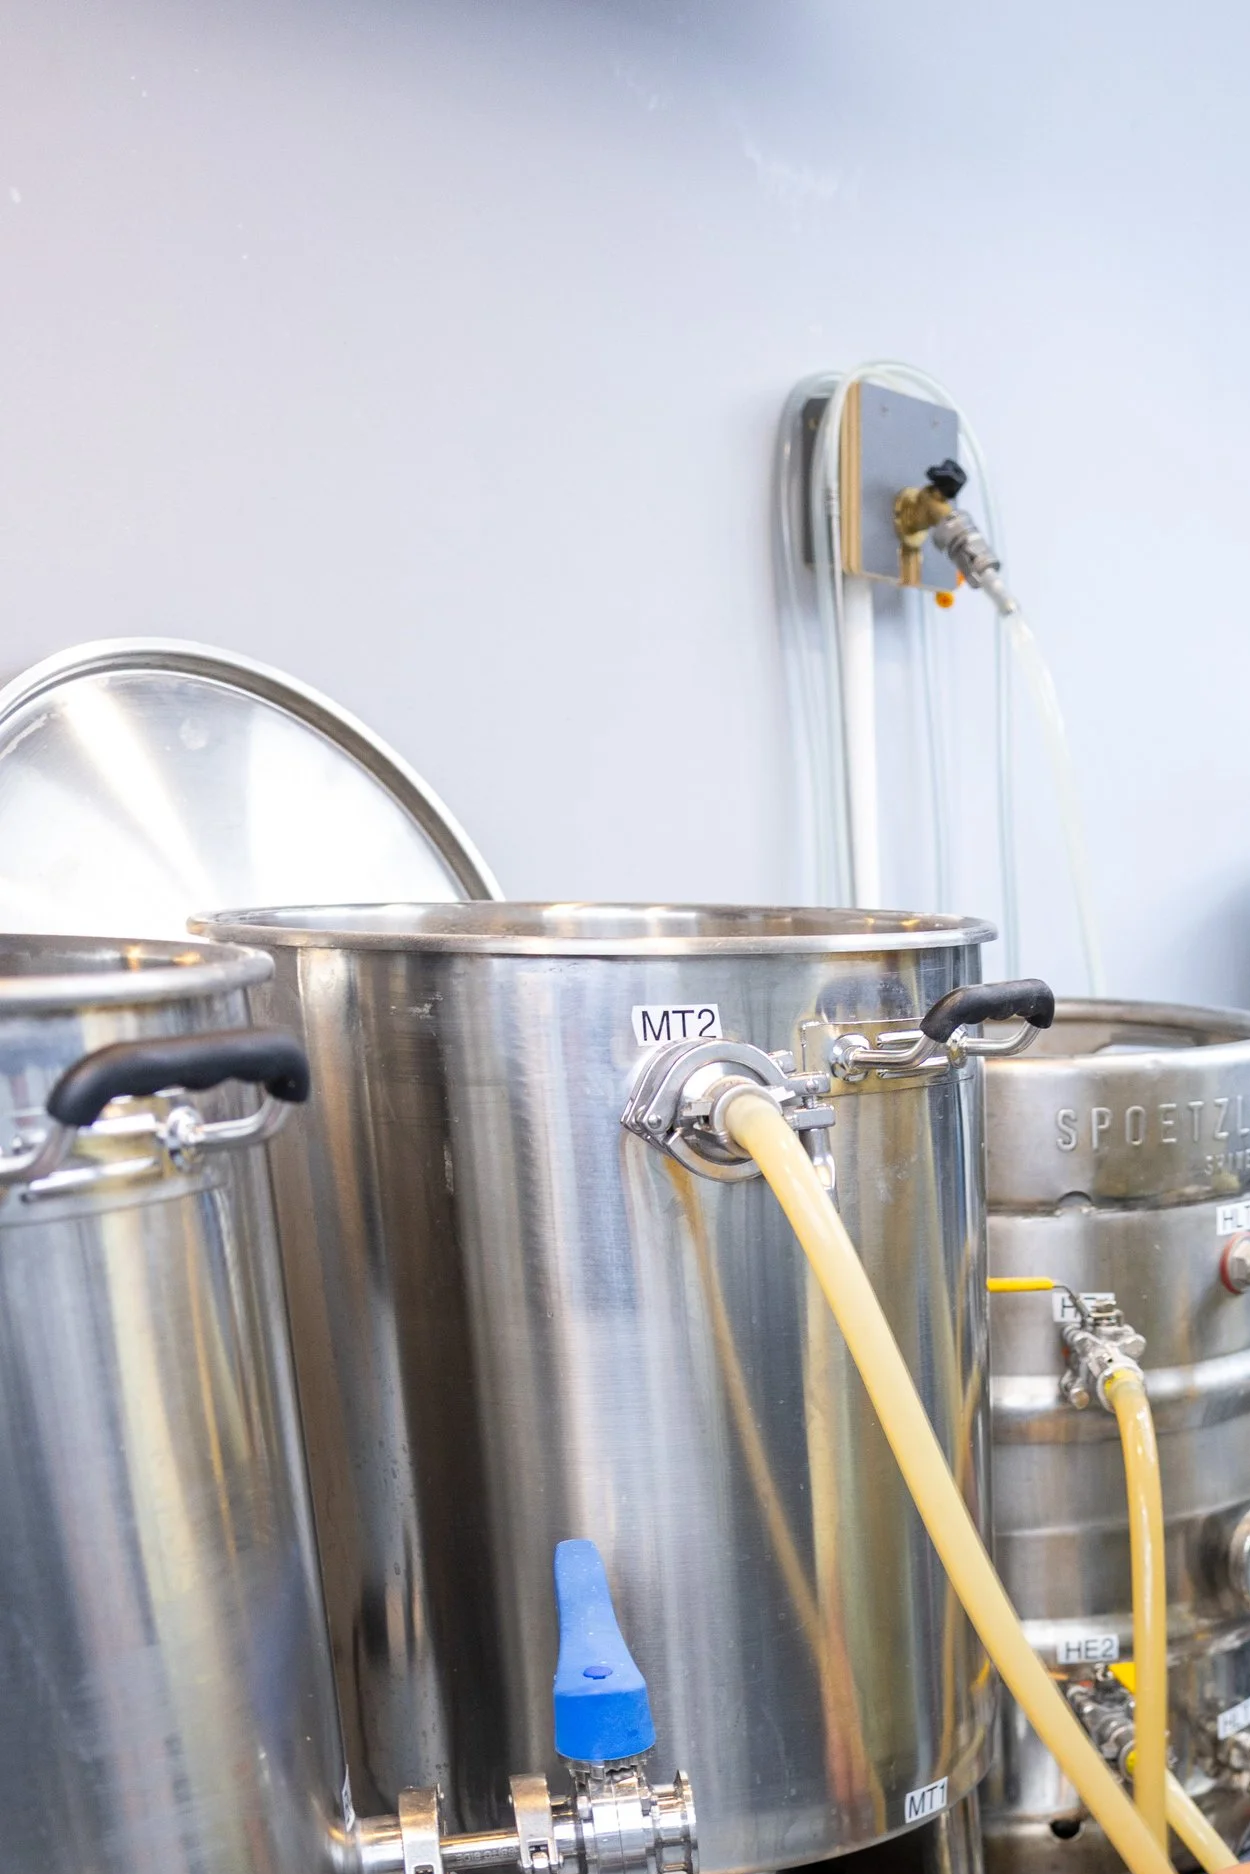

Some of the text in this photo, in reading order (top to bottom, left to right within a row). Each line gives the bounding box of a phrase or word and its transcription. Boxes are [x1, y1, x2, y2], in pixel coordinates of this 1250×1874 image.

[641, 1008, 717, 1041] MT2
[1056, 1095, 1250, 1151] SPOETZL
[1065, 1638, 1114, 1660] HE2
[908, 1781, 945, 1819] MT1
